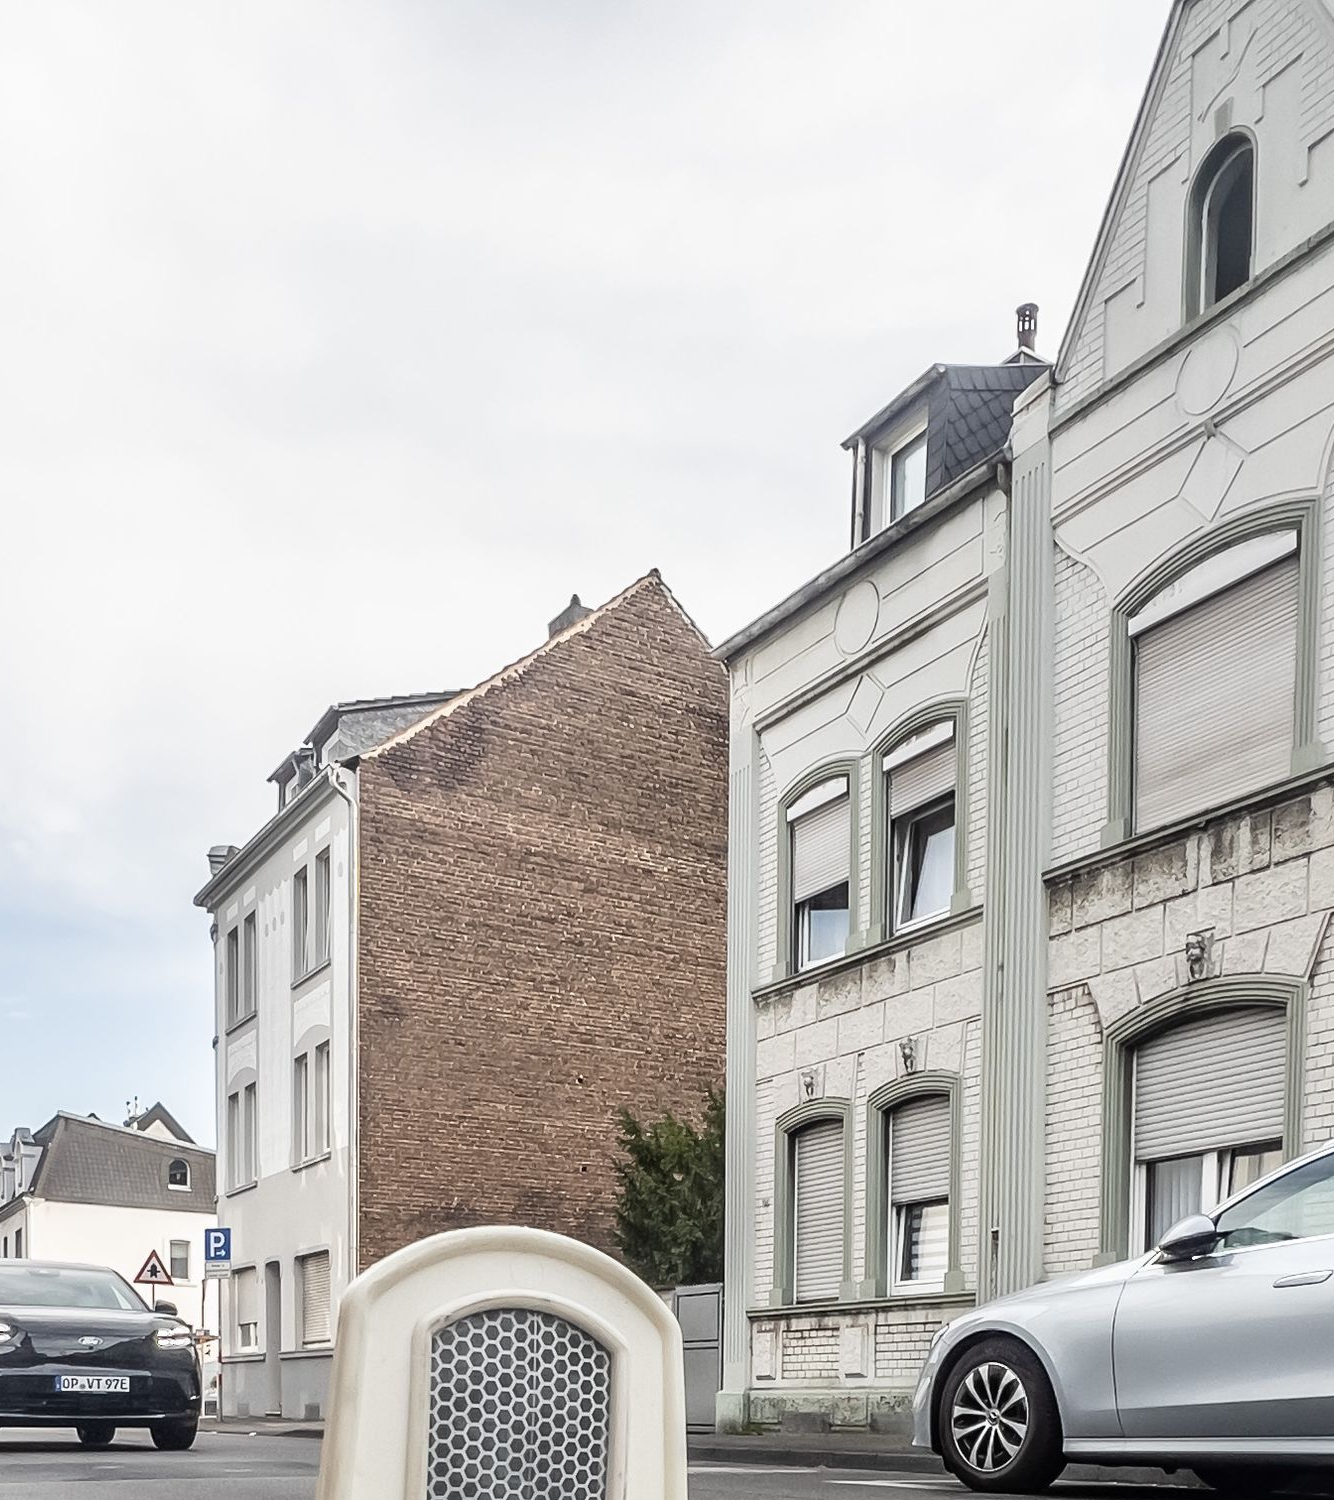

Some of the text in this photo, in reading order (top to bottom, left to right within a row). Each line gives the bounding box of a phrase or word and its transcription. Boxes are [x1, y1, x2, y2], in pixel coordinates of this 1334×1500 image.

[210, 1231, 226, 1258] P
[62, 1377, 129, 1390] OP VT 97E
